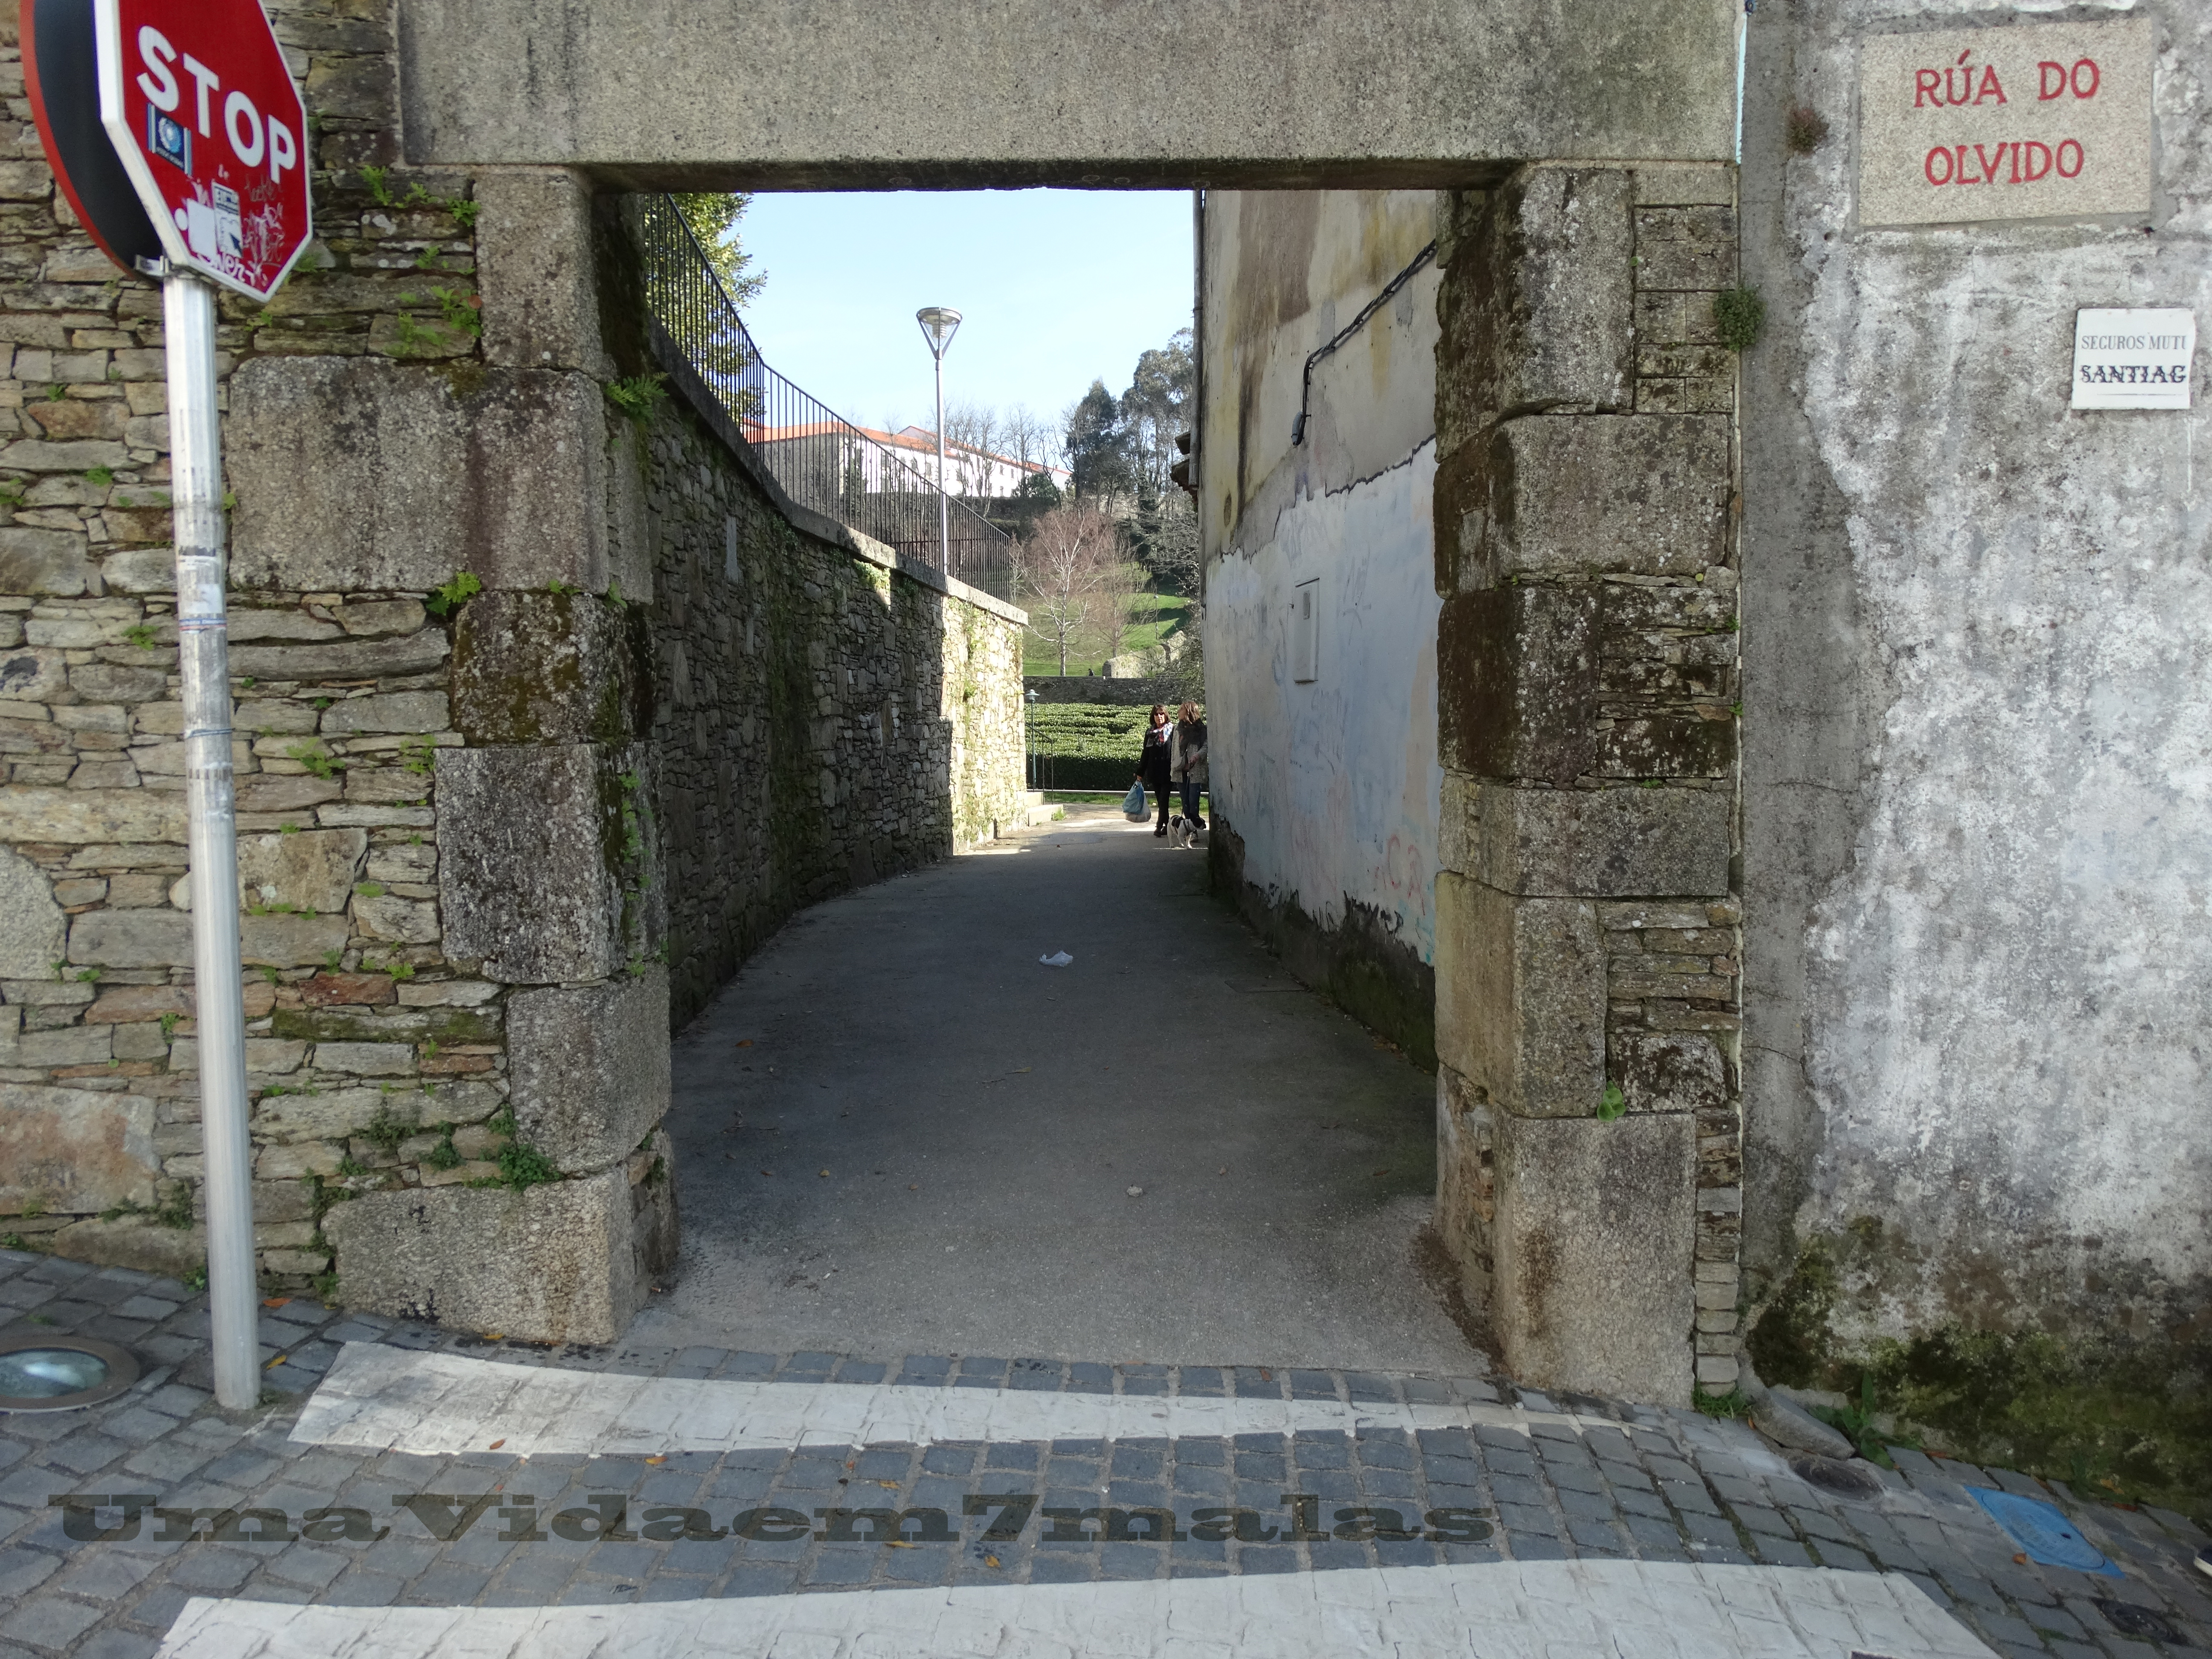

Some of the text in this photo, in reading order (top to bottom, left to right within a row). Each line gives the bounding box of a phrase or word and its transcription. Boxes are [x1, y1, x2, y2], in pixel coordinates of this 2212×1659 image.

[136, 25, 297, 183] STOP
[1913, 49, 2101, 108] RÚA DO
[1924, 138, 2085, 186] OLVIDO
[2081, 335, 2145, 350] SEGUROS
